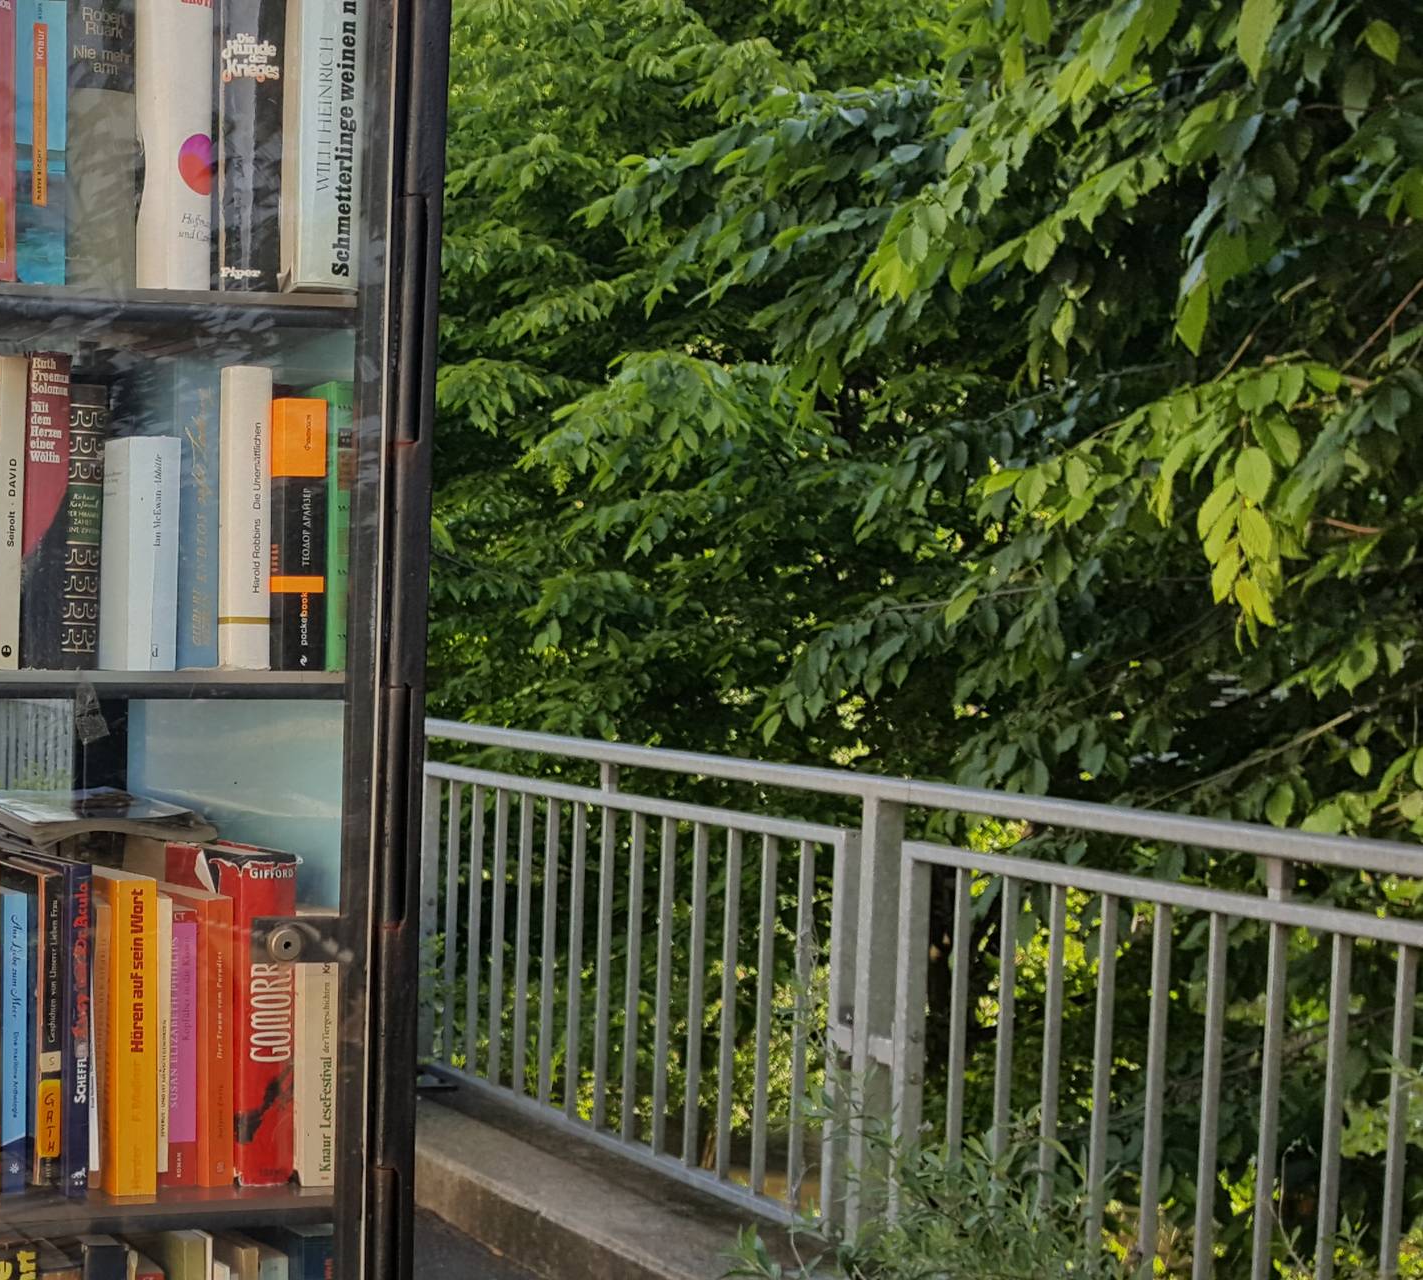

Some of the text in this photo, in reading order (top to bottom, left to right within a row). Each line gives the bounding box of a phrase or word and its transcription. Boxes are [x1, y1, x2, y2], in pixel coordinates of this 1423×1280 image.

[36, 28, 45, 60] Knaur
[73, 46, 96, 59] Nie
[315, 36, 334, 133] HEINRICH
[331, 21, 357, 278] Schmetterlinge weinen
[31, 357, 57, 370] Ruth
[30, 401, 49, 415] Mit
[30, 413, 52, 426] dem
[29, 437, 56, 451] einer
[30, 425, 63, 440] Herzen
[29, 449, 61, 464] Wölfin
[7, 458, 18, 548] Seipolt DAVID
[153, 490, 162, 529] McEwan
[253, 493, 261, 510] Die
[153, 532, 161, 547] Ian
[252, 518, 261, 558] Robbins
[252, 561, 260, 594] Harold
[300, 592, 309, 646] pocketbook
[249, 867, 295, 880] GIFFORD
[49, 919, 58, 945] Lieben
[130, 888, 144, 1053] Hören auf sein Wort
[48, 997, 57, 1043] Geschichten
[249, 962, 292, 1063] GOMORR
[170, 1068, 179, 1109] SUSAN
[319, 1056, 332, 1129] LeseFestival
[319, 1133, 332, 1173] Knaur
